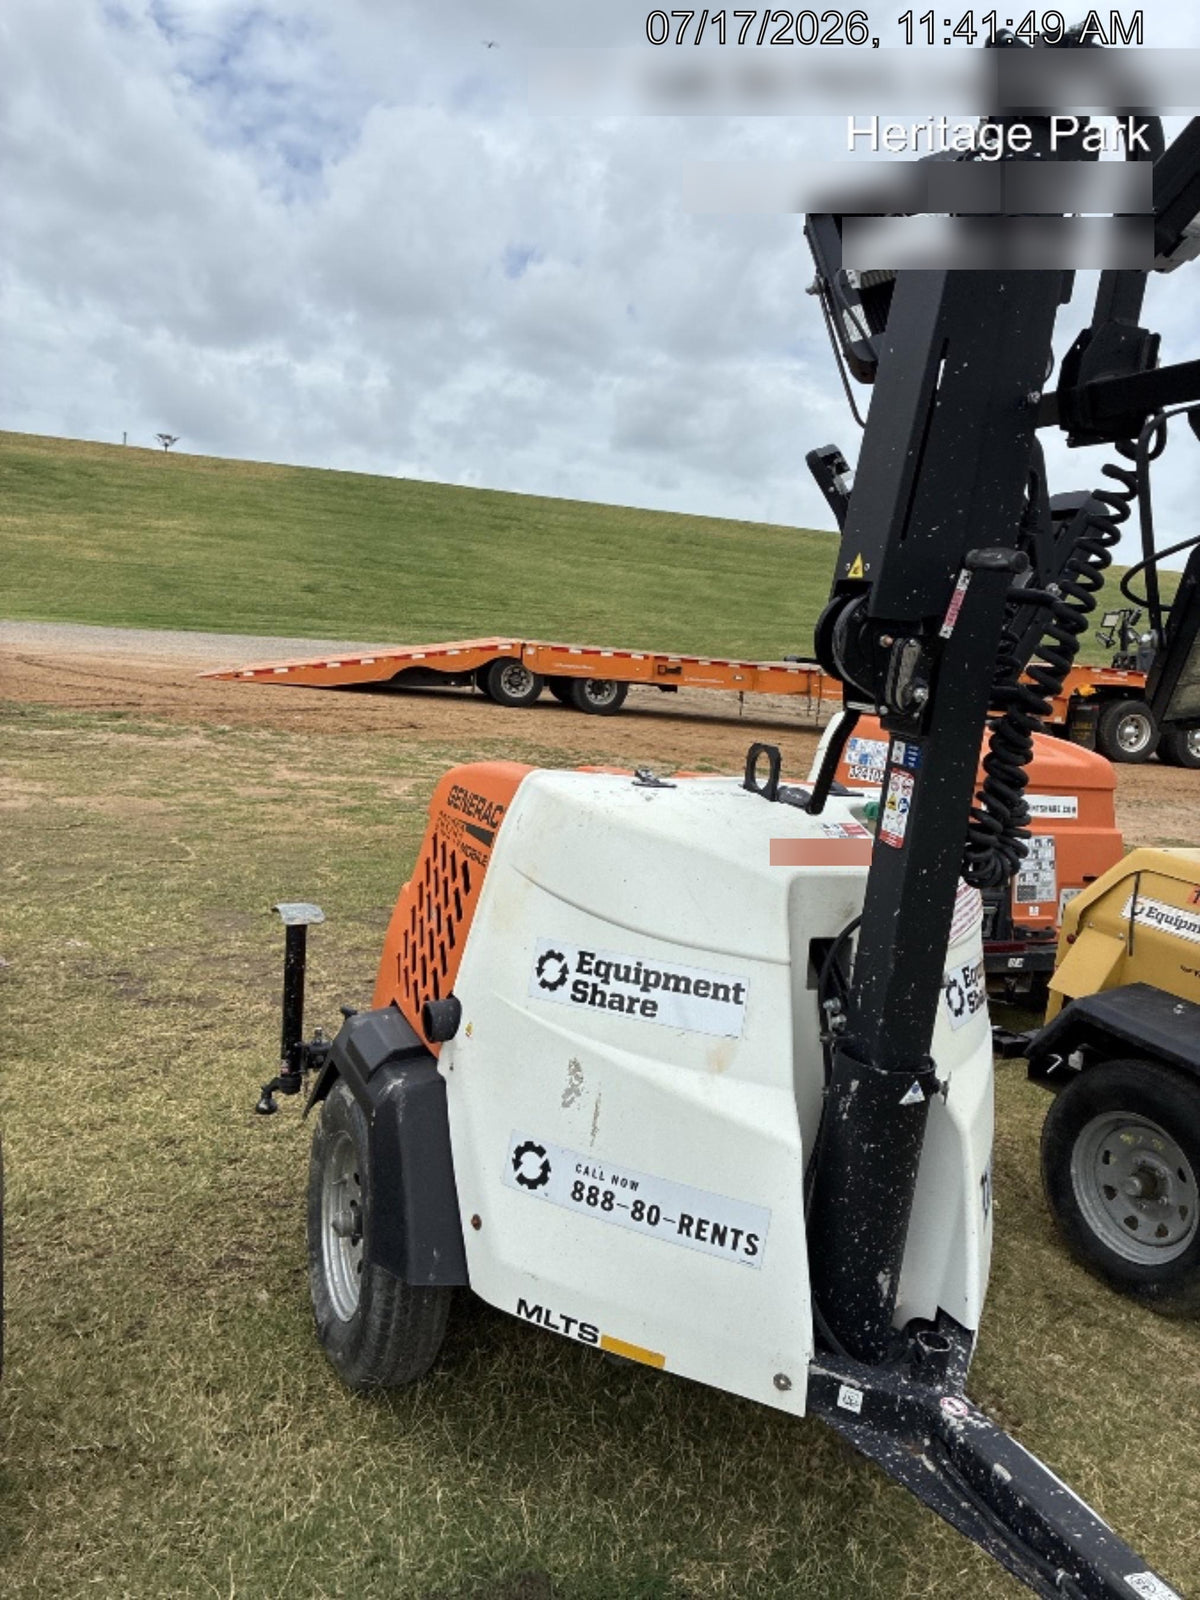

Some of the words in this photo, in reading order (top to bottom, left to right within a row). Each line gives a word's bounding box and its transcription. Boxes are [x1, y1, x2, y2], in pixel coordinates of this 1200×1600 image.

[447, 785, 504, 829] GENERAC
[570, 979, 659, 1018] Share
[575, 950, 746, 1005] Equipment
[575, 1163, 605, 1182] CALL
[611, 1174, 639, 1192] NOW
[571, 1180, 760, 1256] 888-80-RENTS
[516, 1298, 600, 1344] MLTS
